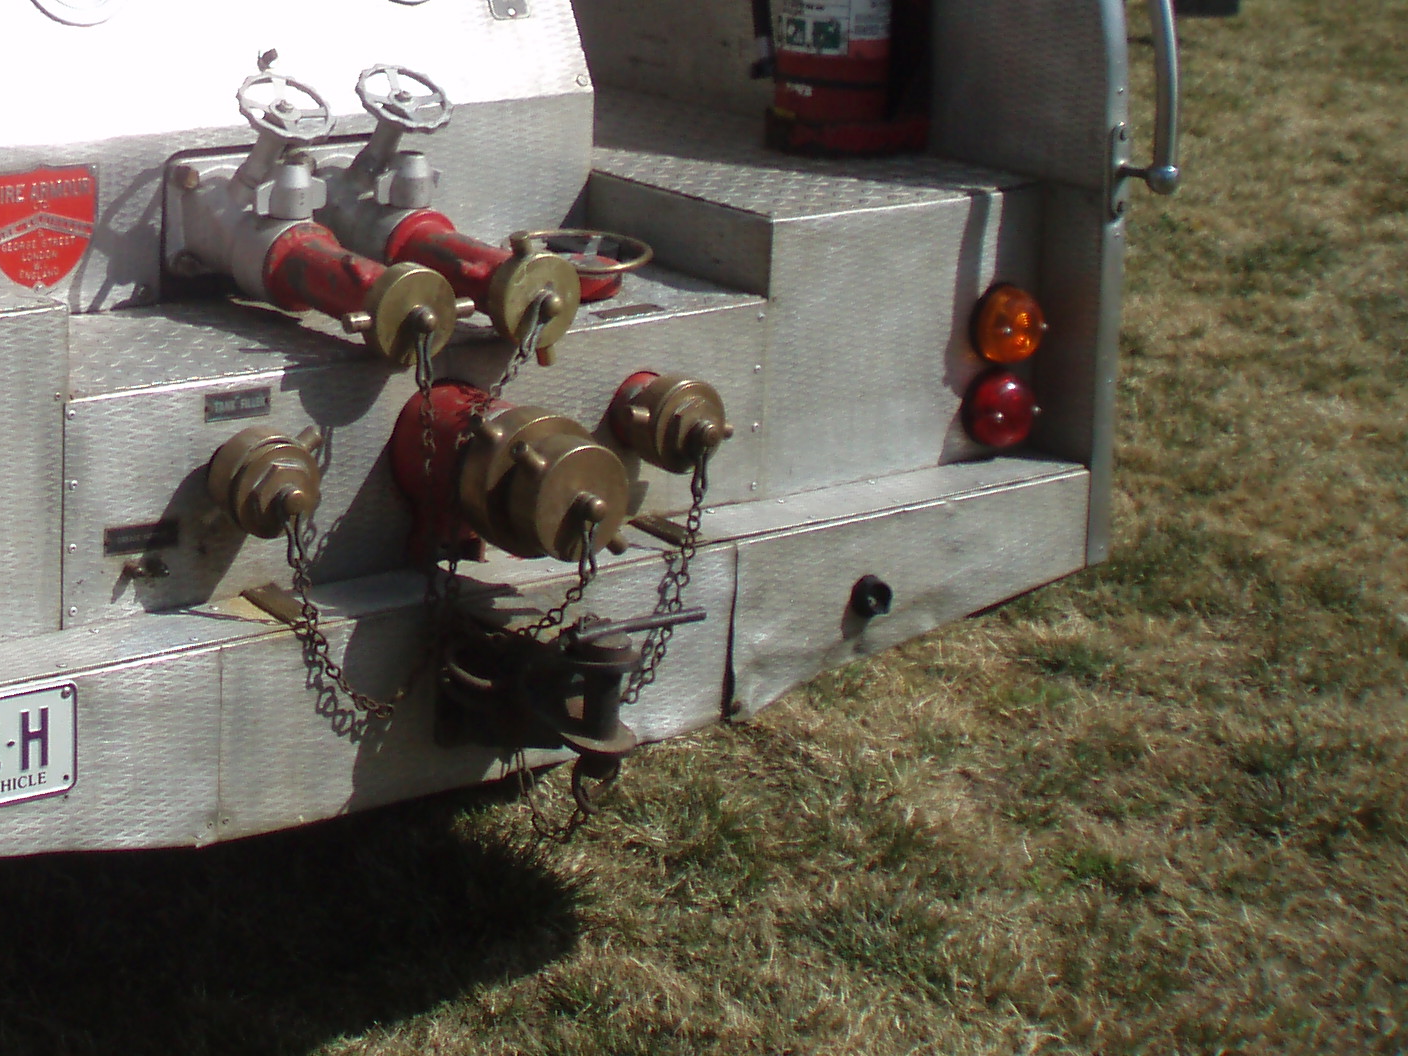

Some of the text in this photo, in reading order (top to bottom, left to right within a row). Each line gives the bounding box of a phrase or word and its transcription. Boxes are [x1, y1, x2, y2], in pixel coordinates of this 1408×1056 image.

[30, 177, 91, 200] ARMOUR
[1, 235, 76, 252] GEORGE STREET
[20, 250, 58, 262] LONDON
[19, 266, 59, 280] ENGLAND
